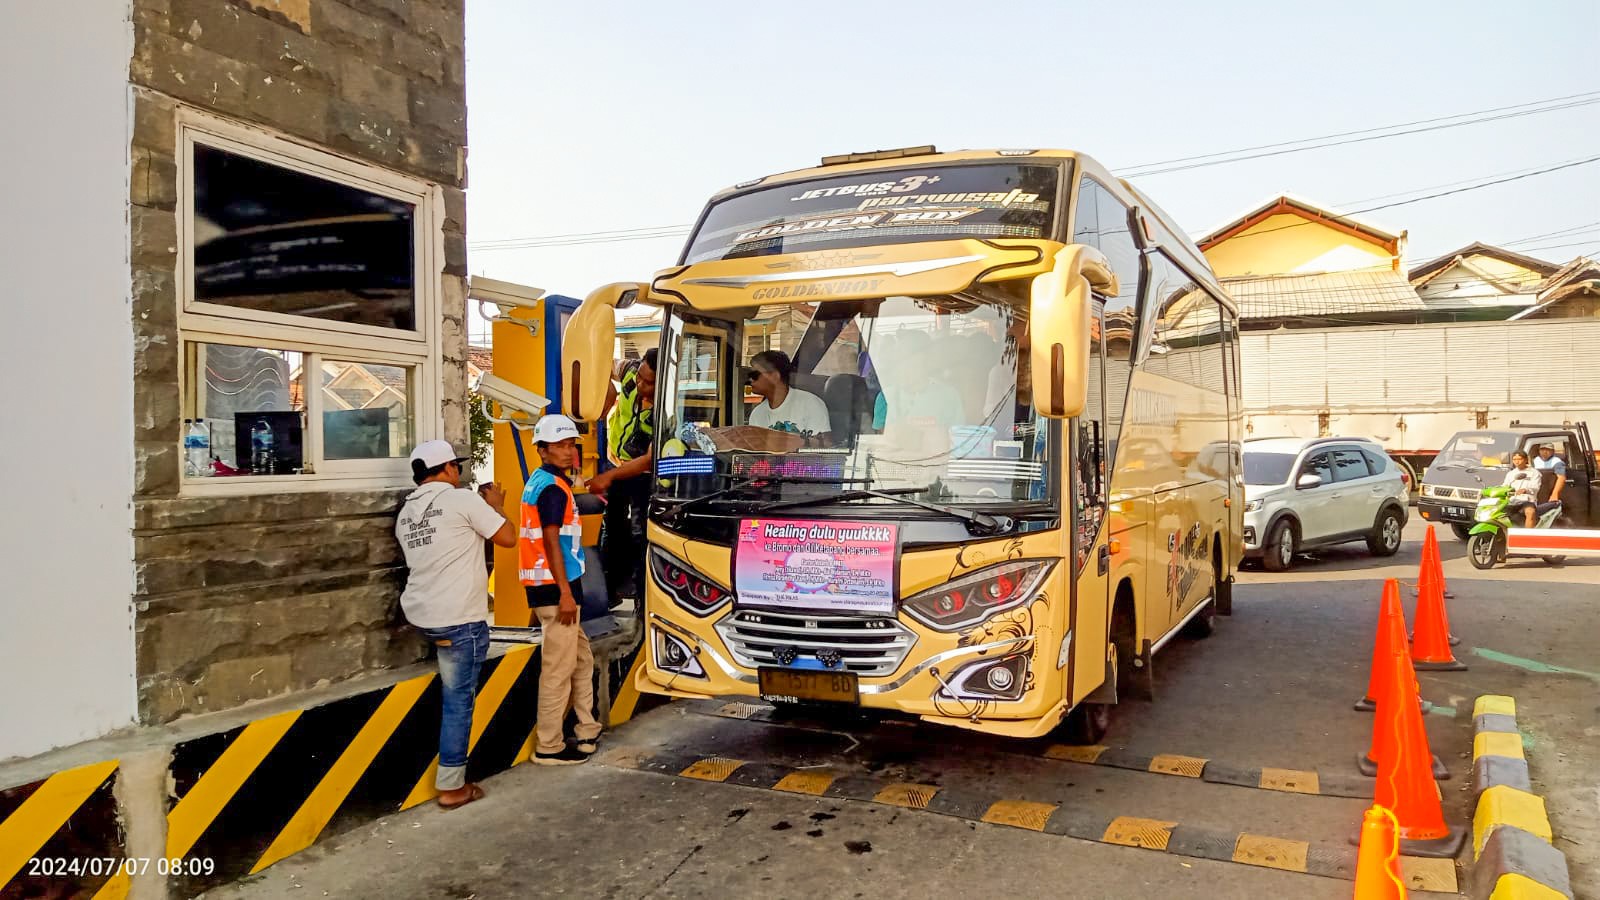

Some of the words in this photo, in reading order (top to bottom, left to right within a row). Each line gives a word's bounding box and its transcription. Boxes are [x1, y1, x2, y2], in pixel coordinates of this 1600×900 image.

[734, 213, 885, 242] GOLDEN
[892, 209, 970, 222] BOY
[764, 523, 807, 541] Healing
[809, 524, 836, 540] dulu
[838, 527, 890, 543] yuukkkk
[772, 542, 791, 553] Bromo
